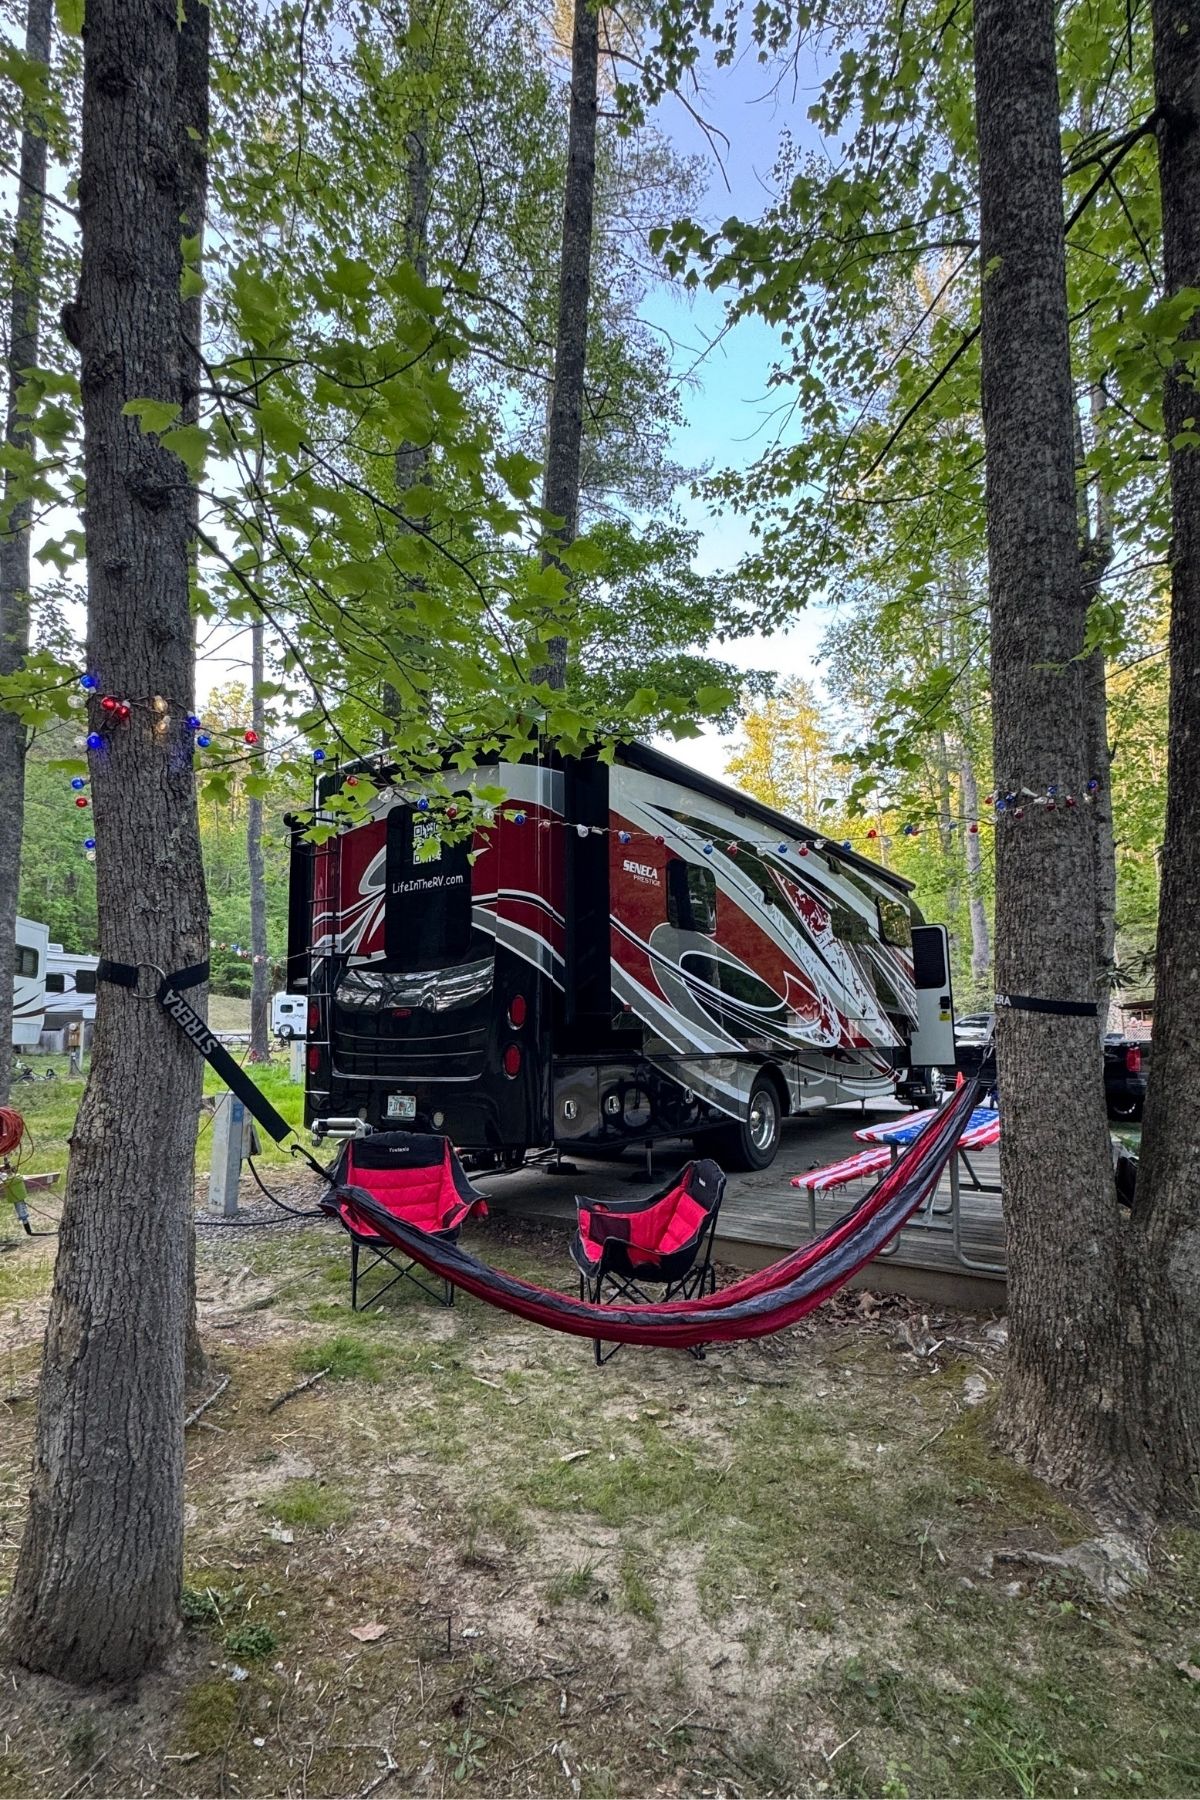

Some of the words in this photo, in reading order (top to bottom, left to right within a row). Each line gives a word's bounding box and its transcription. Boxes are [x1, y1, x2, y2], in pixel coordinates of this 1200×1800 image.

[623, 859, 658, 879] SENECA
[392, 874, 464, 894] LifeInTheRV.com
[162, 989, 218, 1054] STRERA
